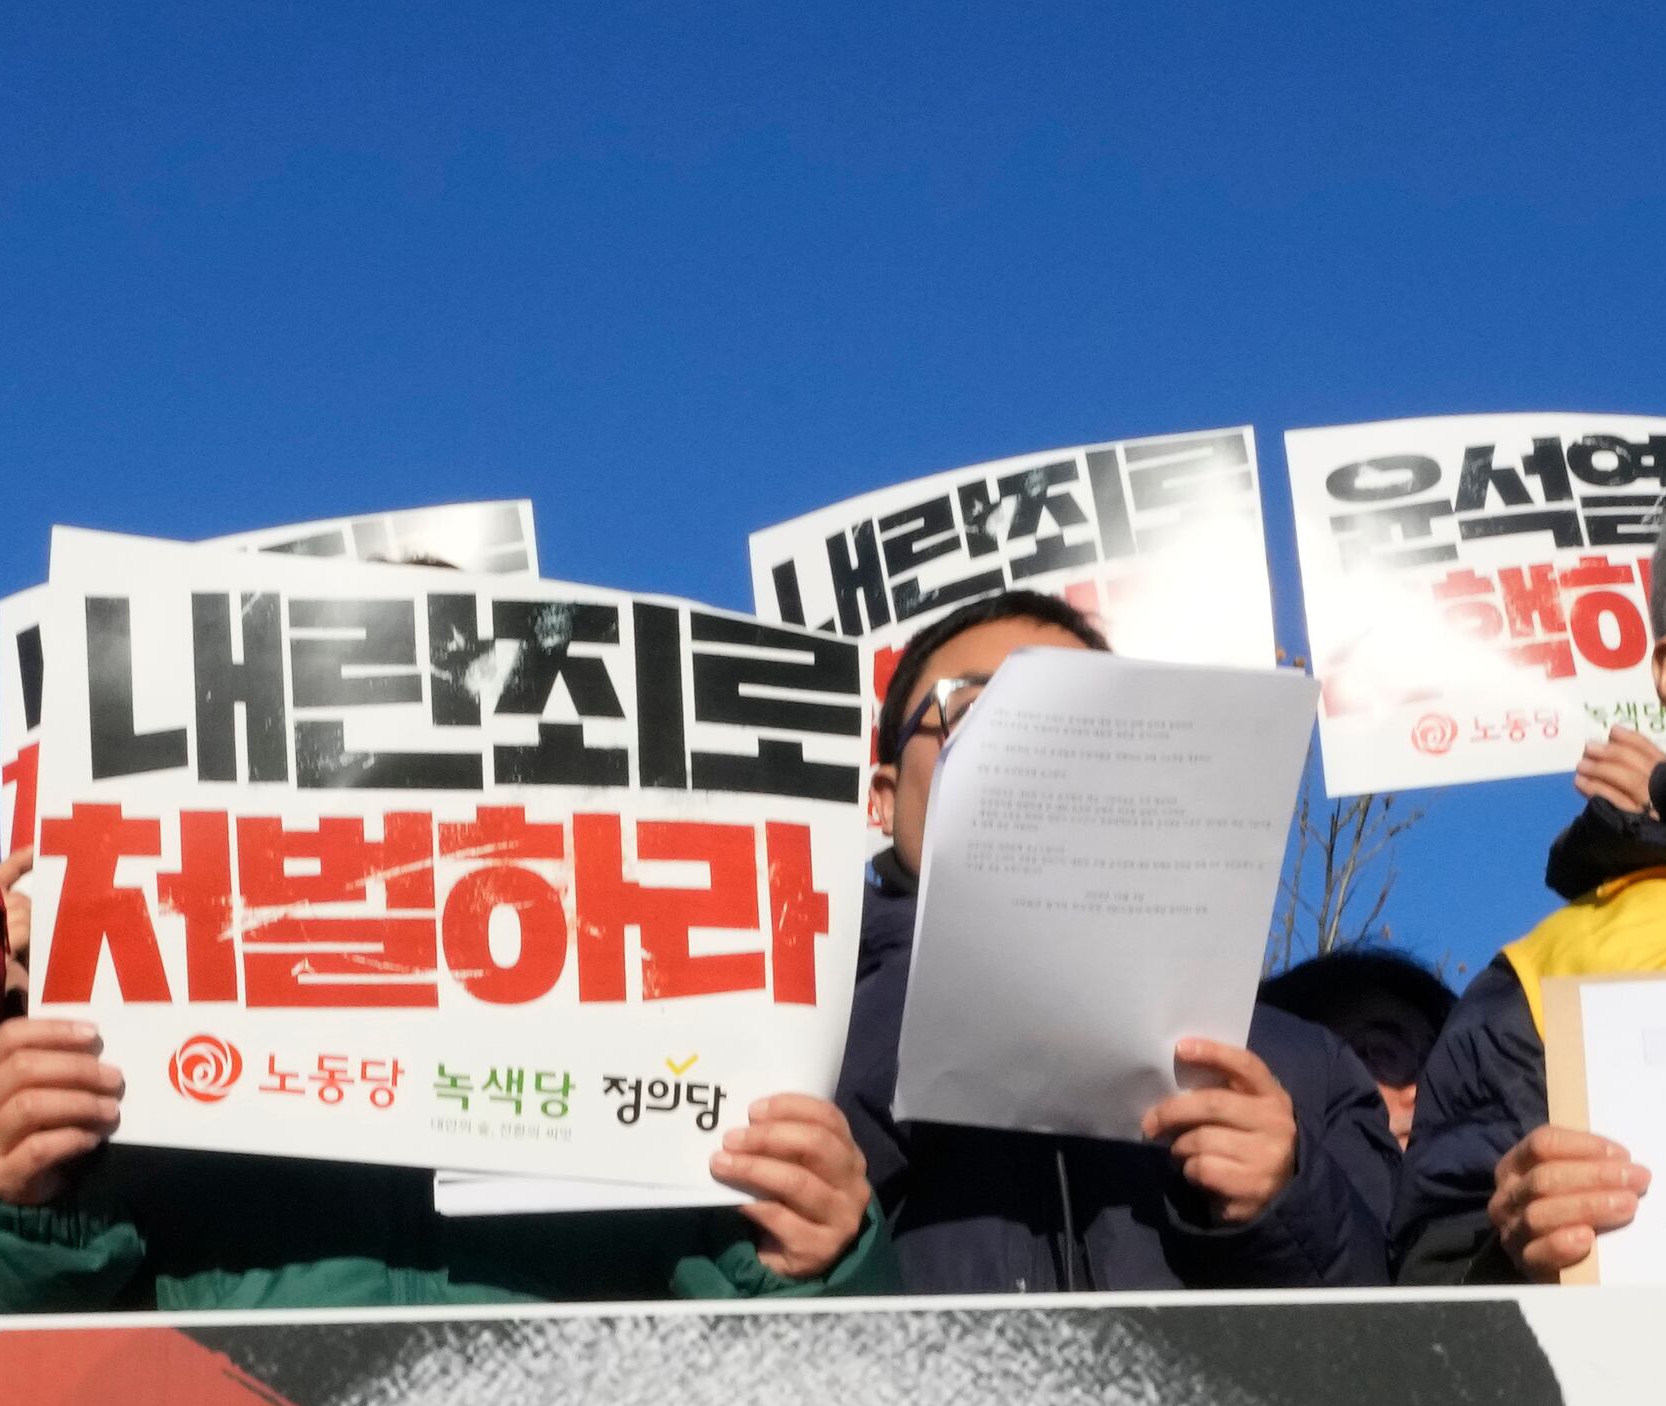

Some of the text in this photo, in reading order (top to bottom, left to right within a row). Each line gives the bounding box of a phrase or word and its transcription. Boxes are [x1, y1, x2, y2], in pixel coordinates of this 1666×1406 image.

[85, 591, 861, 804] 내란죄로
[1469, 709, 1561, 743] 노동당
[39, 803, 830, 1009] 처벌하라
[258, 1051, 728, 1132] 노동당 녹색당 정의당
